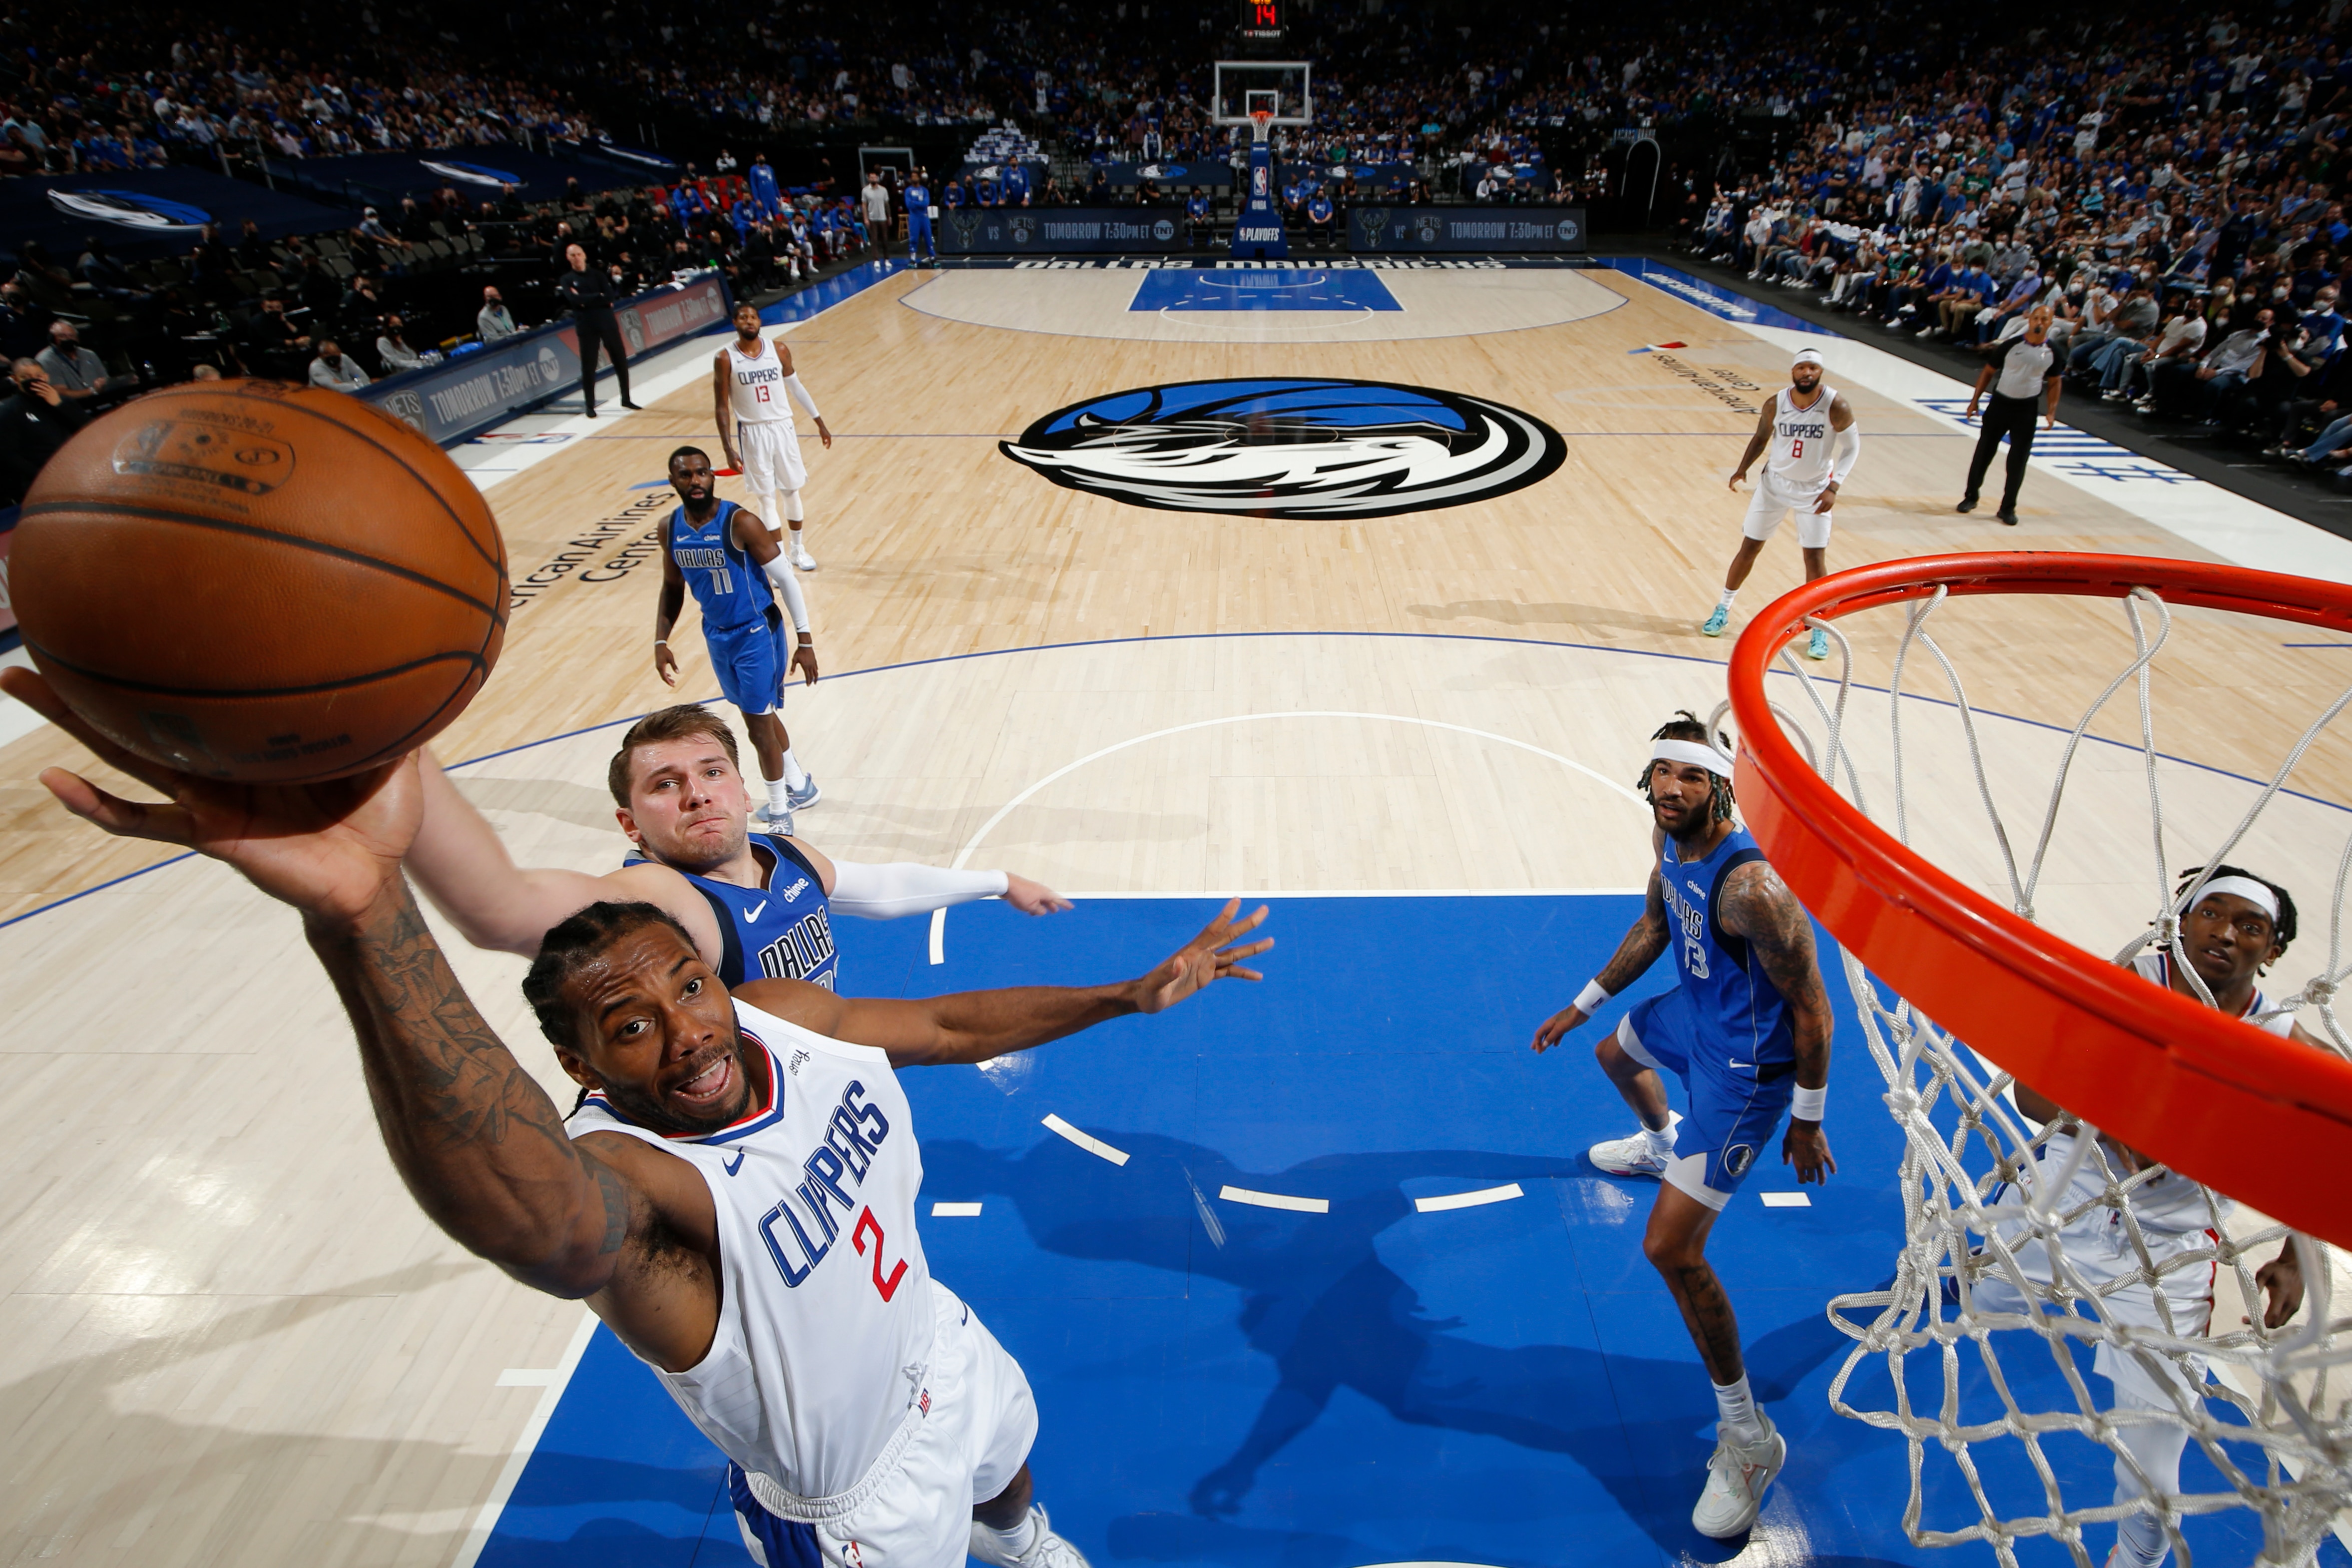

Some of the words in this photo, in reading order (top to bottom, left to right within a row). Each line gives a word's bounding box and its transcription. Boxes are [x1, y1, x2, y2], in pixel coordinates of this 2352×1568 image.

[1256, 4, 1276, 25] 14
[1009, 217, 1034, 229] NETS
[1044, 223, 1100, 239] TOMORROW
[1415, 216, 1441, 228] NETS
[1450, 222, 1505, 238] TOMORROW
[988, 226, 999, 239] VS
[1246, 228, 1280, 241] PLAYOFFS
[1014, 260, 1193, 269] DALLAS
[1215, 260, 1506, 269] MAVERICKS
[738, 367, 778, 385] CLIPPERS
[1708, 368, 1761, 391] Center
[429, 374, 497, 424] TOMORROW
[755, 385, 770, 403] 13
[1691, 377, 1762, 415] American
[385, 393, 421, 418] NETS
[1779, 423, 1824, 439] CLIPPERS
[1792, 440, 1803, 458] 8
[568, 492, 675, 549] Airlines
[579, 527, 659, 582] Cente
[674, 548, 726, 568] DALLAS
[708, 568, 734, 595] 11
[784, 878, 809, 903] chime
[1687, 880, 1706, 900] chime
[1660, 872, 1703, 940] DALLAS
[757, 905, 834, 980] DALLAS
[758, 1080, 890, 1288] CLIPPERS
[852, 1204, 909, 1303] 2
